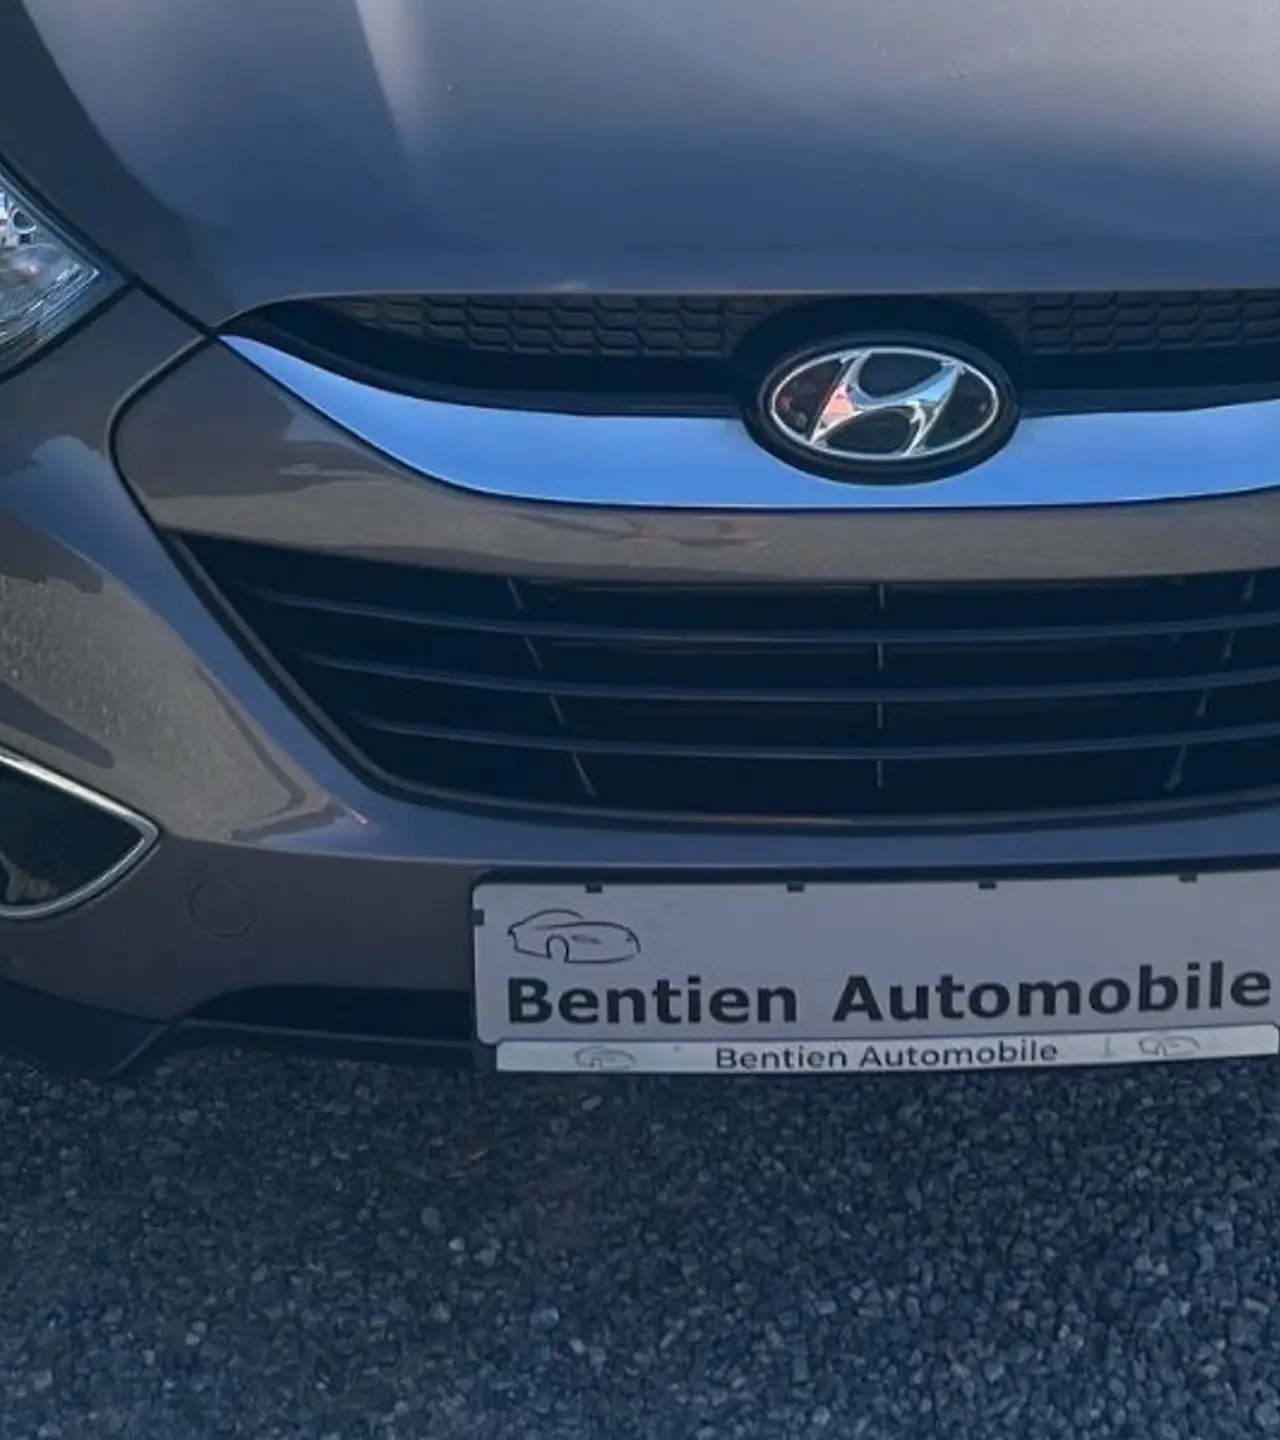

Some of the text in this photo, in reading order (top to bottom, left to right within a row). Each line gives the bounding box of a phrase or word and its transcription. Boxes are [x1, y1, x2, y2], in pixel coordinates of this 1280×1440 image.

[507, 961, 1272, 1026] Bentien Automobile
[715, 1039, 1058, 1070] Bentien Automobile
